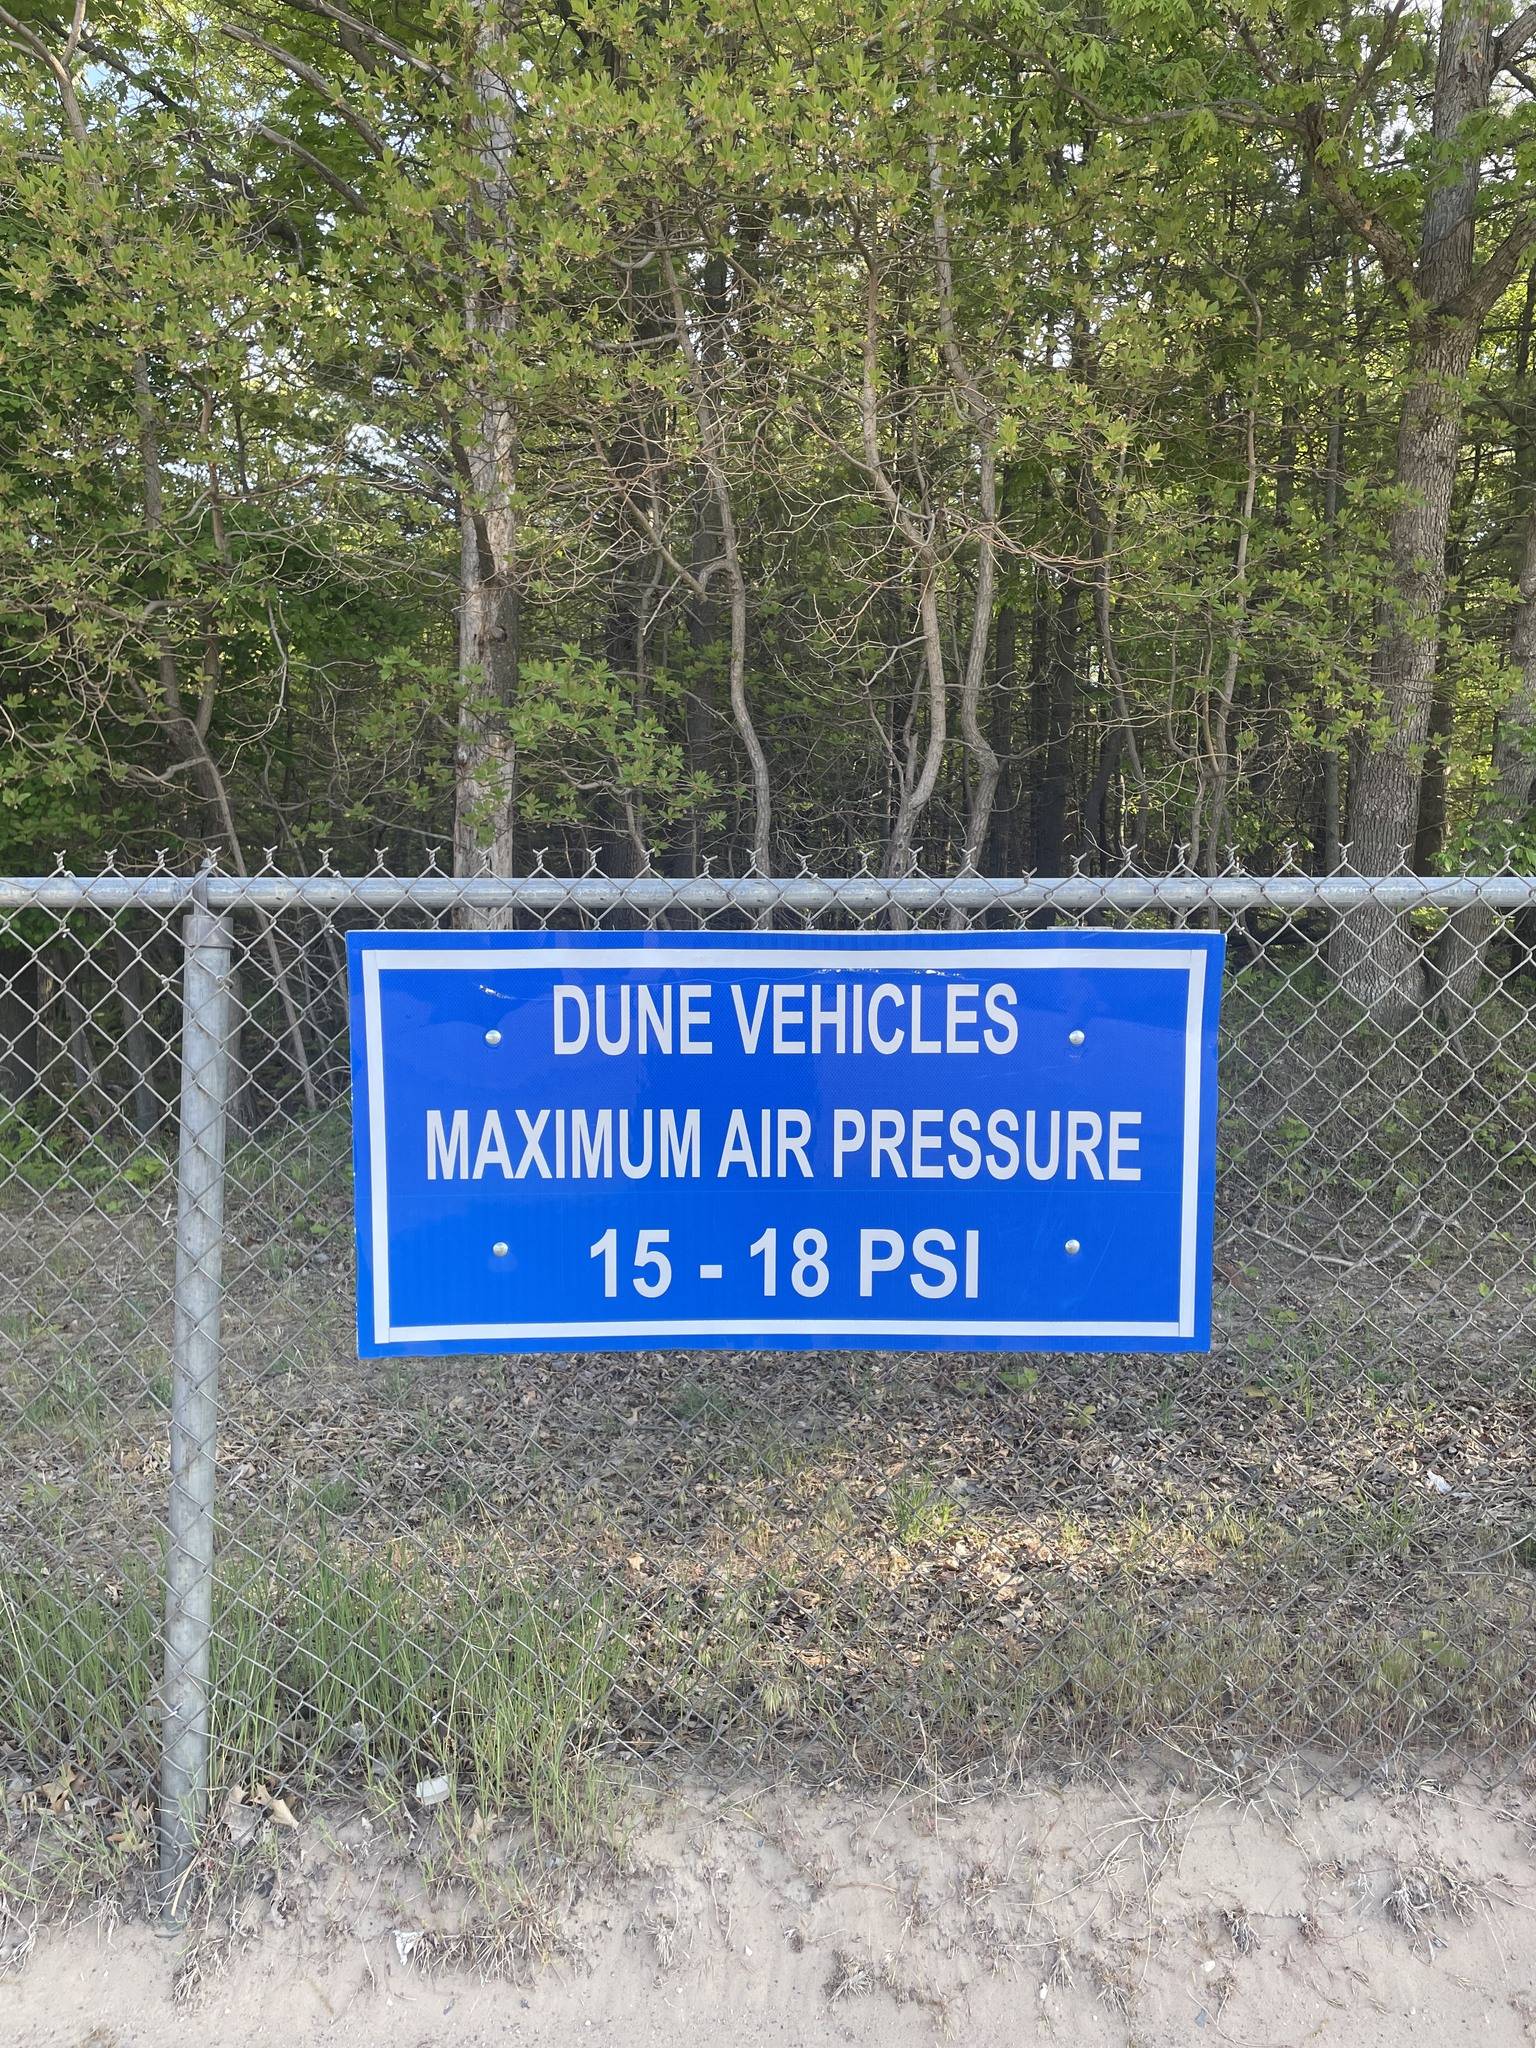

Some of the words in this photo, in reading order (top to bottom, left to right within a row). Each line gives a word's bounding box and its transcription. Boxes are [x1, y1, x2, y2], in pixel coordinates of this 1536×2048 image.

[553, 984, 713, 1056] DUNE
[731, 982, 1019, 1055] VEHICLES
[426, 1109, 701, 1180] MAXIMUM
[717, 1108, 814, 1178] AIR
[833, 1108, 1142, 1181] PRESSURE
[590, 1228, 672, 1298] 15
[699, 1264, 723, 1279] -
[750, 1228, 830, 1298] 18
[859, 1228, 979, 1299] PSI
